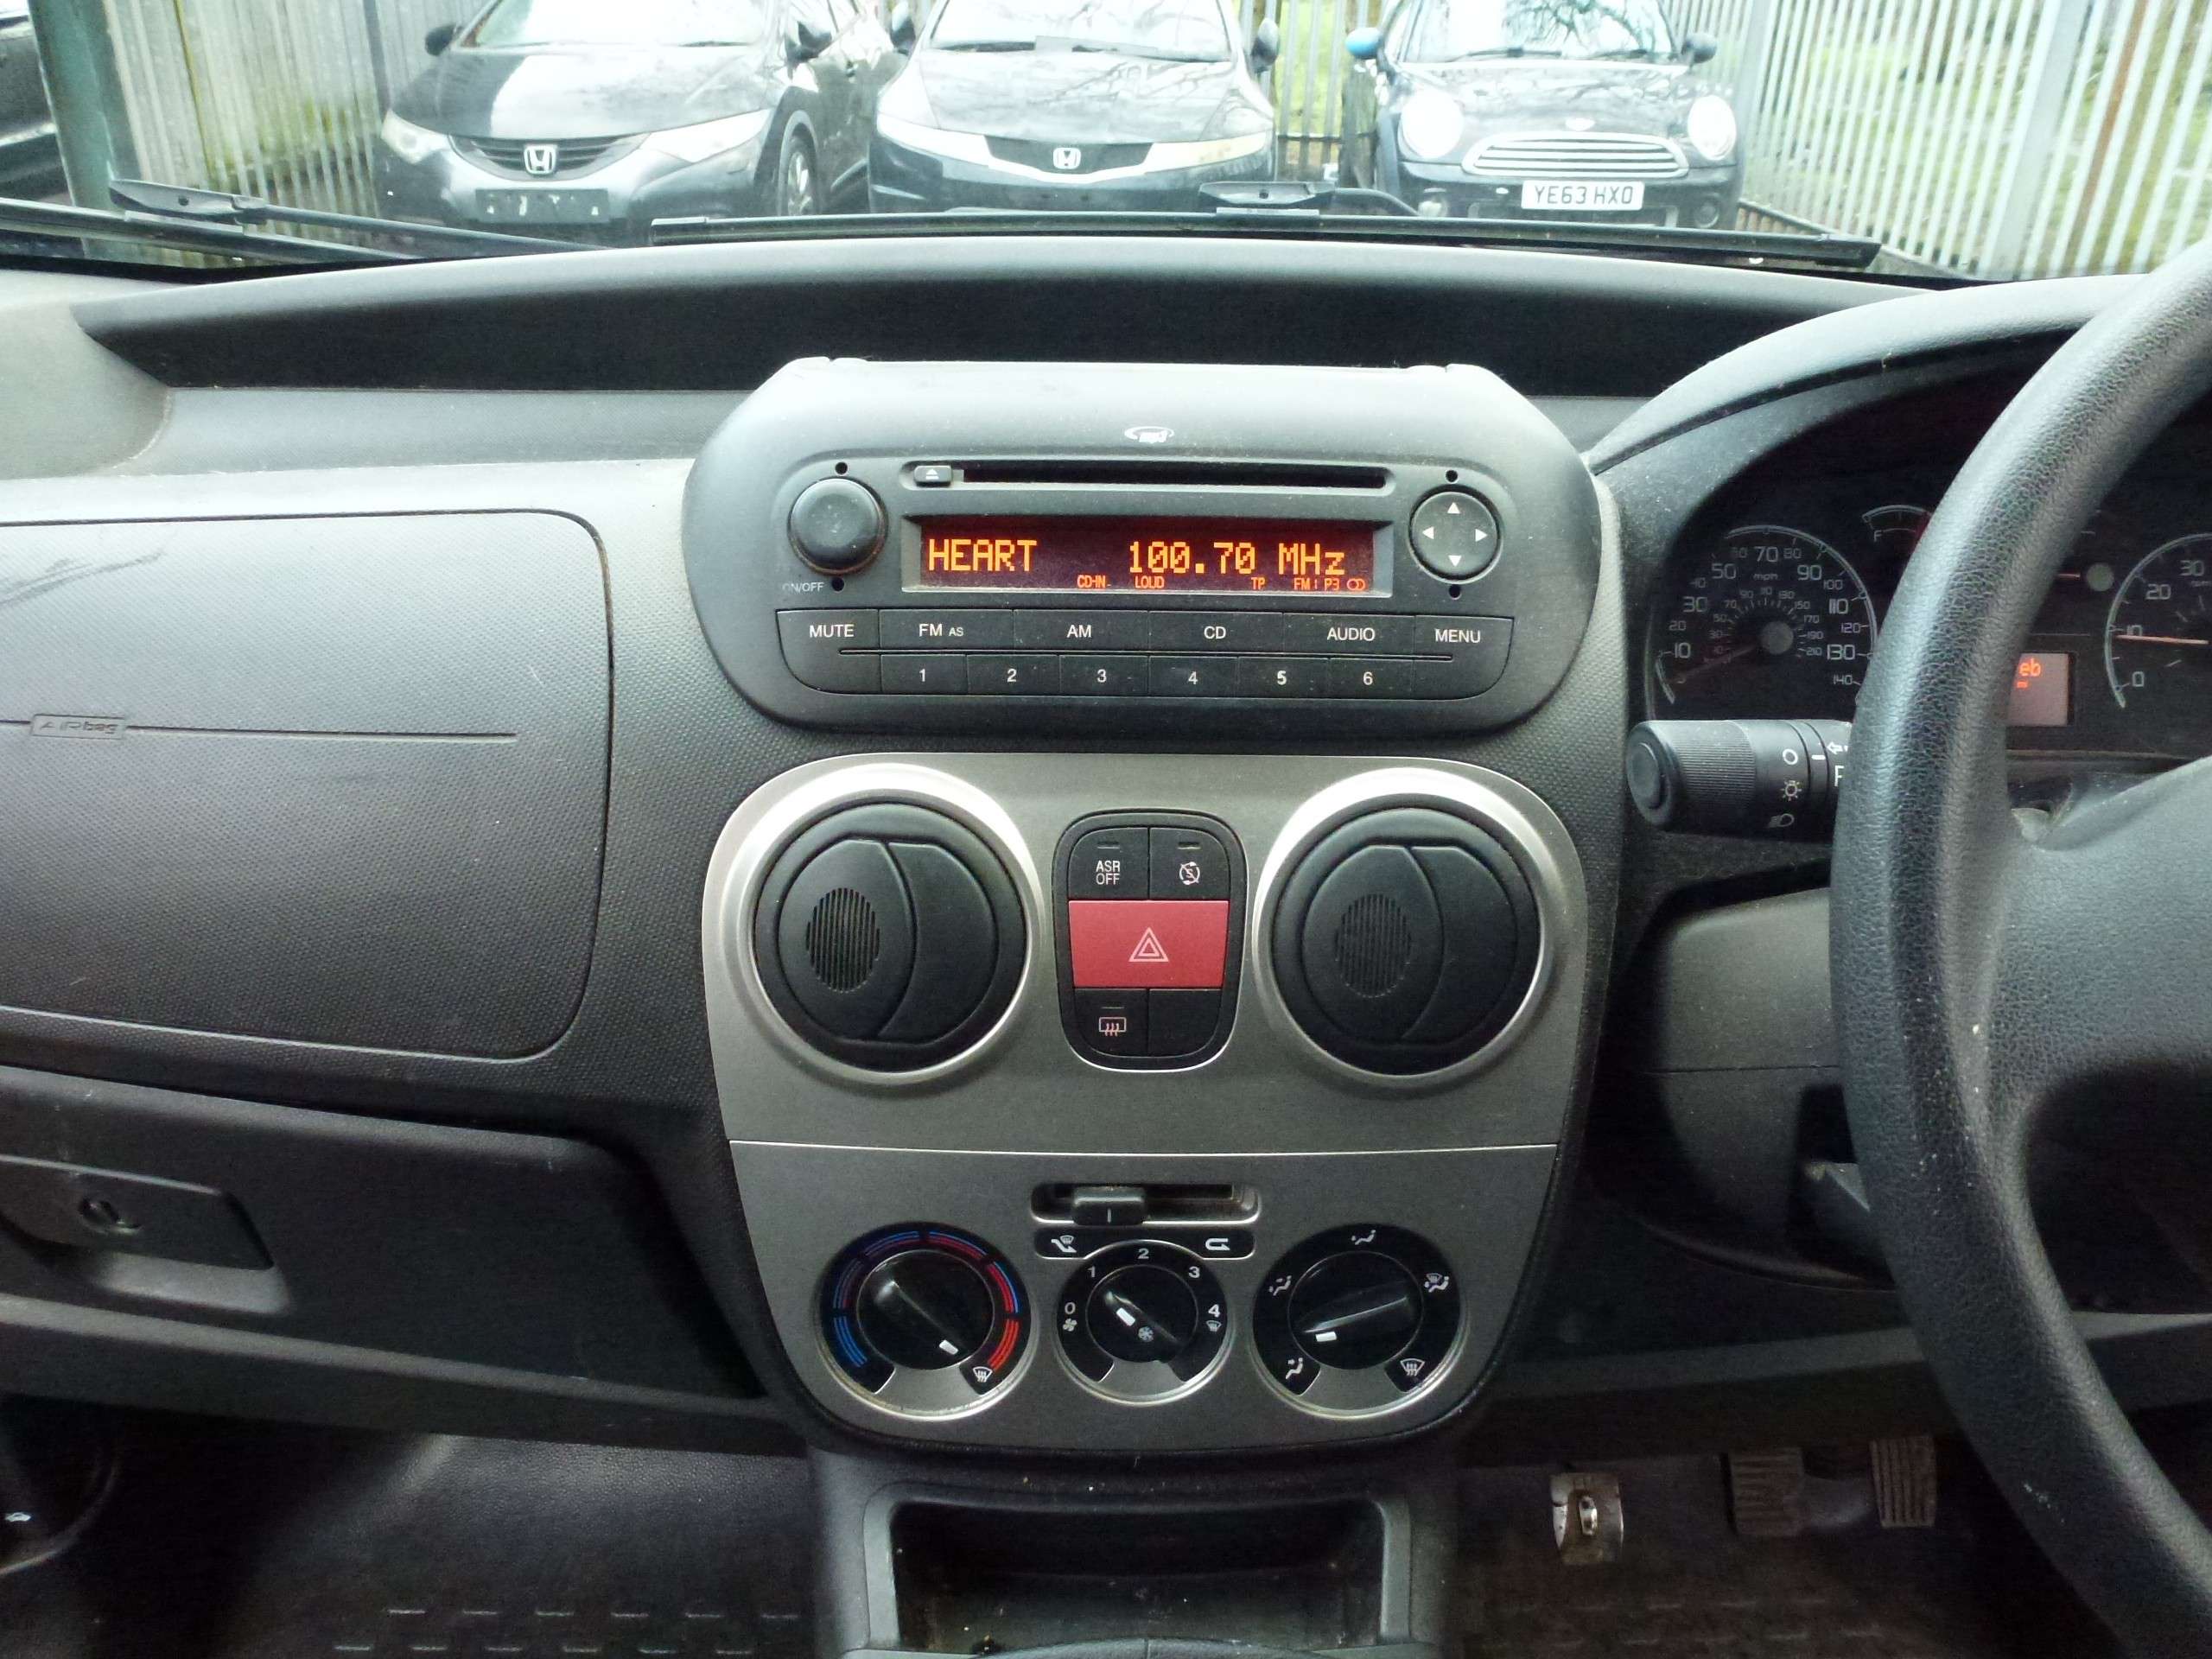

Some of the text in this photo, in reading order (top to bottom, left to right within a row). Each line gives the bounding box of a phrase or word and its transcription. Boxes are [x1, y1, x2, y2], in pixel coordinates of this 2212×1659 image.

[1535, 186, 1587, 204] YE63
[929, 538, 1344, 575] HEART 100.70 MHz
[1754, 546, 1778, 563] 70
[1711, 563, 1737, 580] 50
[1796, 564, 1822, 581] 90
[2179, 560, 2204, 576] 30
[1135, 576, 1165, 589] LOUD
[1250, 577, 1265, 589] TP
[1753, 572, 1778, 582] mph
[1823, 580, 1843, 590] 100
[2145, 584, 2171, 600] 20
[1683, 596, 1708, 613] 30
[1828, 598, 1849, 614] 110
[809, 624, 855, 638] MUTE
[918, 624, 964, 637] FM AS
[1066, 625, 1092, 638] AM
[1204, 626, 1226, 639] CD
[1669, 620, 1687, 632] 20
[1841, 622, 1861, 634] 120
[1327, 628, 1376, 641] AUDIO
[1435, 629, 1481, 643] MENU
[1674, 642, 1691, 659] 10
[1827, 644, 1856, 660] 130
[2018, 658, 2042, 677] eb
[918, 669, 927, 683] 1
[1007, 669, 1017, 683] 2
[1096, 669, 1107, 683] 3
[1188, 671, 1198, 685] 4
[1276, 671, 1287, 685] 5
[1363, 671, 1373, 685] 6
[1833, 675, 1853, 685] 140
[2132, 671, 2145, 688] 0
[1096, 861, 1121, 873] ASR
[1096, 873, 1120, 885] OFF
[1137, 1248, 1149, 1260] 2
[1088, 1266, 1096, 1278] 1
[1188, 1266, 1200, 1279] 3
[1208, 1304, 1221, 1318] 4
